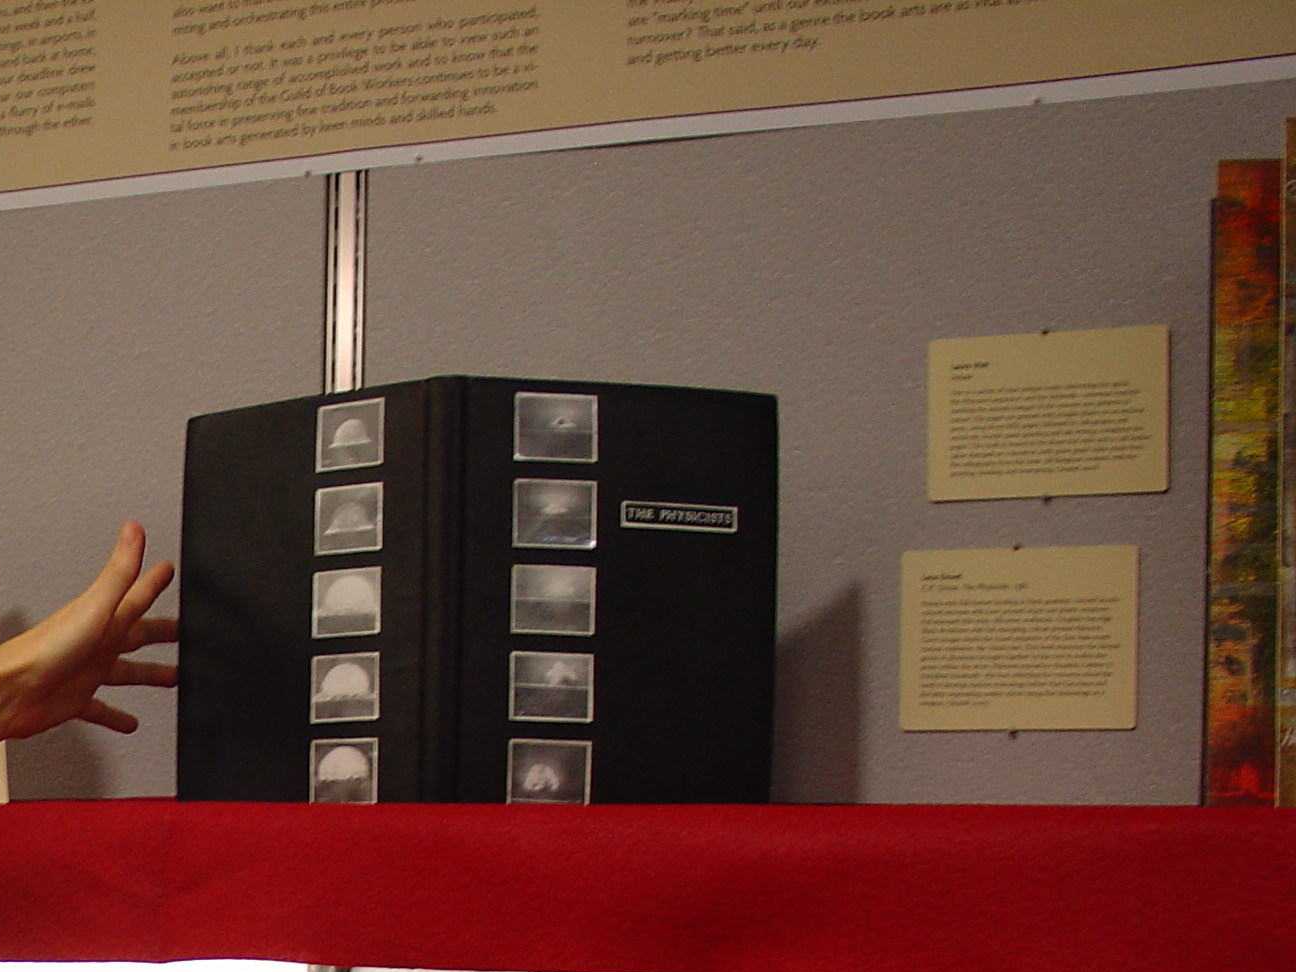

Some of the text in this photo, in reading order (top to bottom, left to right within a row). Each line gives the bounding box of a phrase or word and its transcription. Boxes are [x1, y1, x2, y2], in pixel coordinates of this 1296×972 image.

[762, 22, 776, 31] as
[858, 4, 894, 21] book
[312, 32, 334, 46] and
[377, 24, 422, 41] person
[426, 17, 454, 31] who
[372, 45, 387, 56] to
[389, 40, 407, 53] be
[441, 36, 455, 47] to
[625, 51, 653, 65] and
[750, 40, 789, 52] every
[271, 72, 287, 86] of
[407, 54, 431, 69] and
[434, 55, 449, 65] to
[313, 84, 328, 97] of
[476, 67, 490, 77] to
[374, 93, 399, 108] and
[182, 134, 212, 149] book
[300, 122, 317, 137] by
[388, 110, 414, 125] and
[627, 507, 732, 526] THE PHYSICISTS
